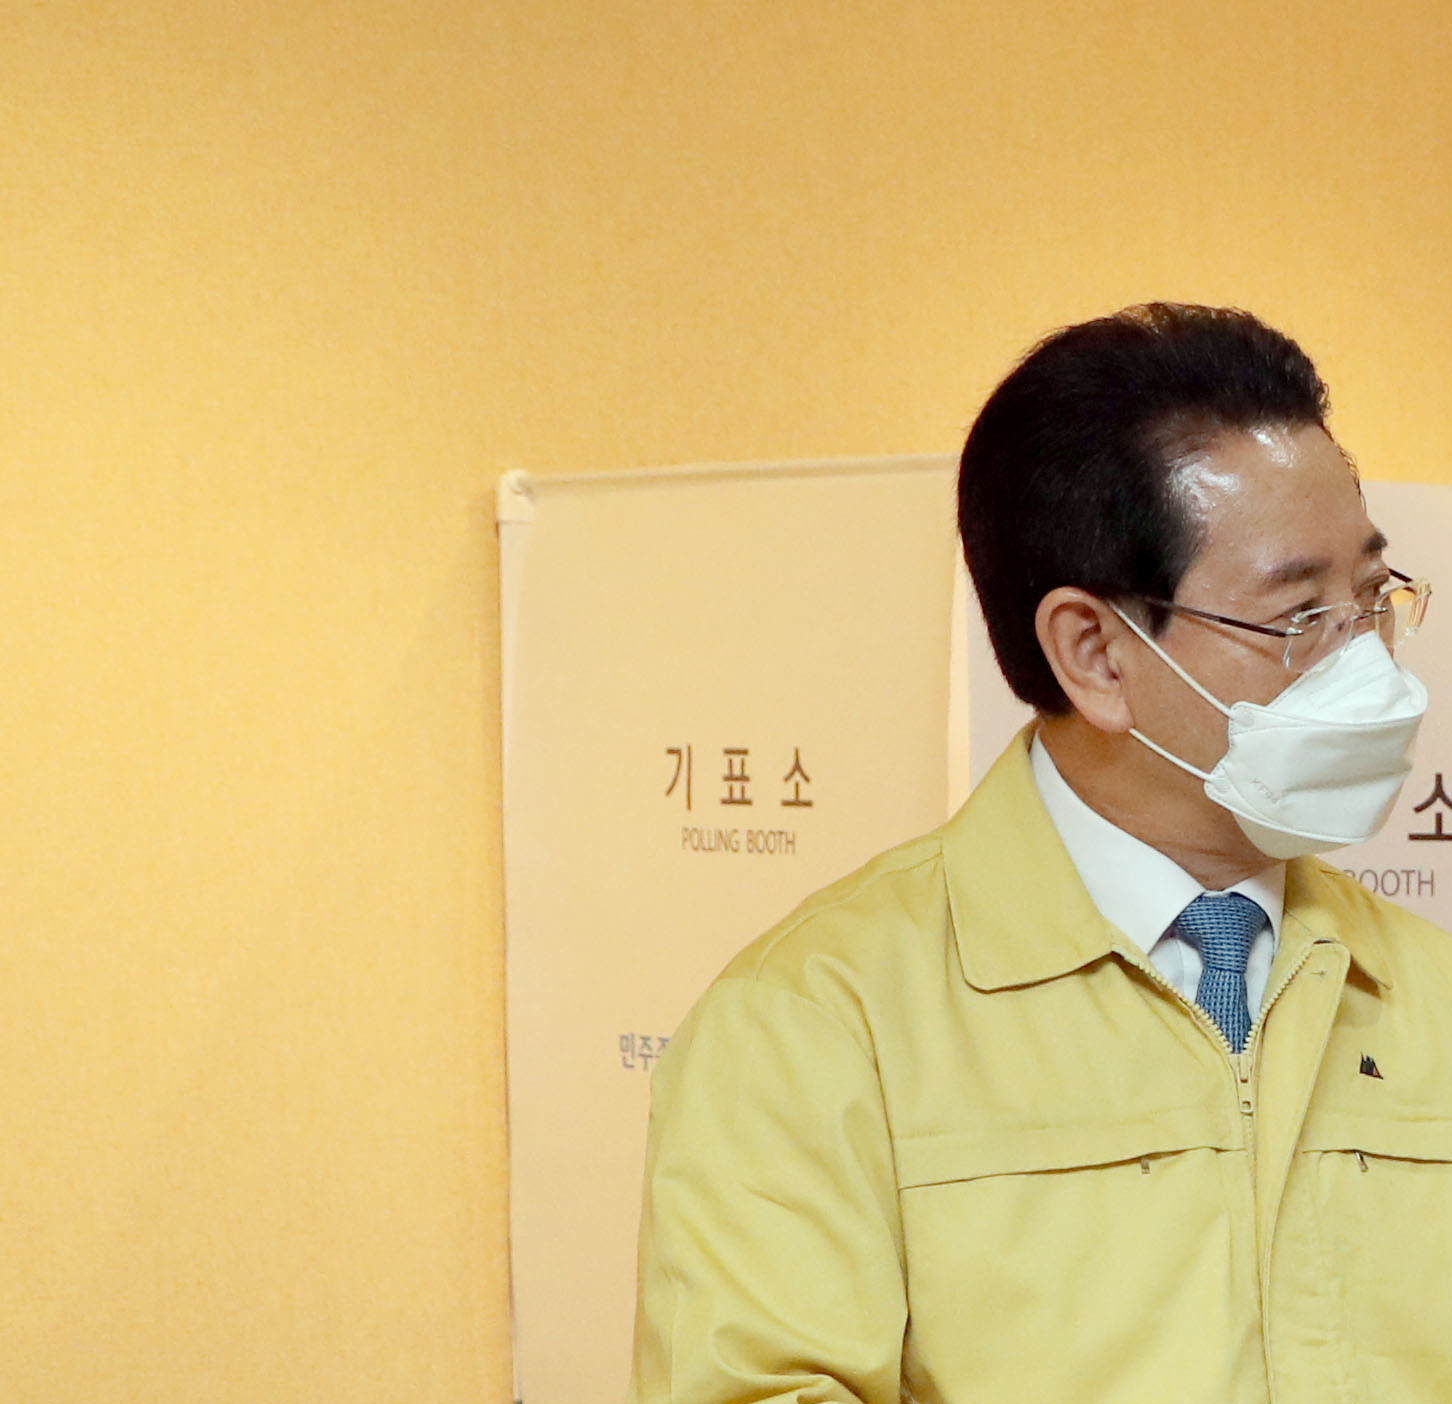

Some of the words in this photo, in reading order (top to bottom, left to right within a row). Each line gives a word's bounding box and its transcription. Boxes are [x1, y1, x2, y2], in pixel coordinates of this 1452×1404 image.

[681, 827, 740, 853] POLLING
[746, 829, 796, 855] BOOTH
[1343, 868, 1435, 897] OOTH
